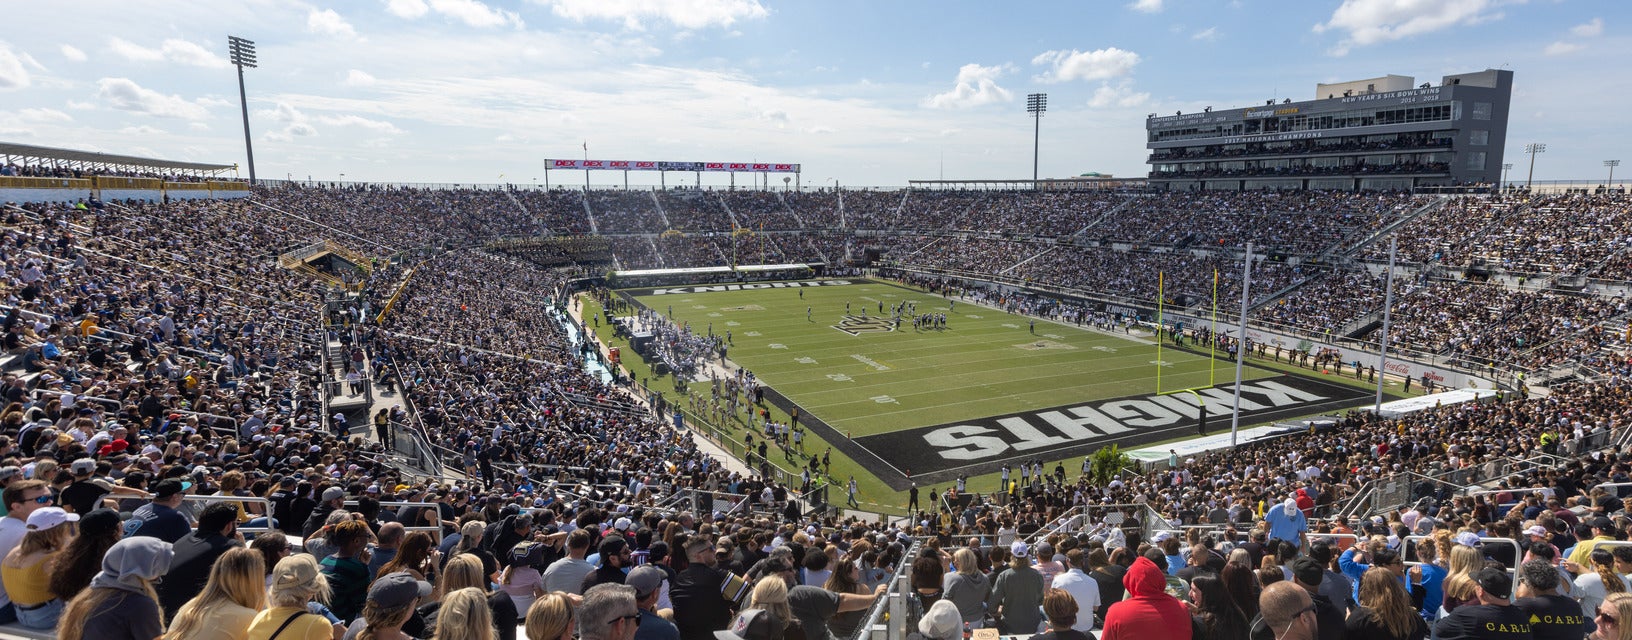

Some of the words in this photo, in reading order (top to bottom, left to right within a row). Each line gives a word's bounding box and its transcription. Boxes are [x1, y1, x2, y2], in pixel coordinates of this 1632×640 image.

[1357, 94, 1382, 102] YEAR'S
[1420, 87, 1440, 95] WINS
[1179, 113, 1205, 121] CHAMPIONS
[1242, 135, 1275, 143] NATIONAL
[1278, 132, 1322, 140] CHAMPIONS
[1105, 304, 1138, 317] KNIGHTS
[1423, 371, 1445, 382] Wawa
[922, 380, 1331, 461] KNIGHTS
